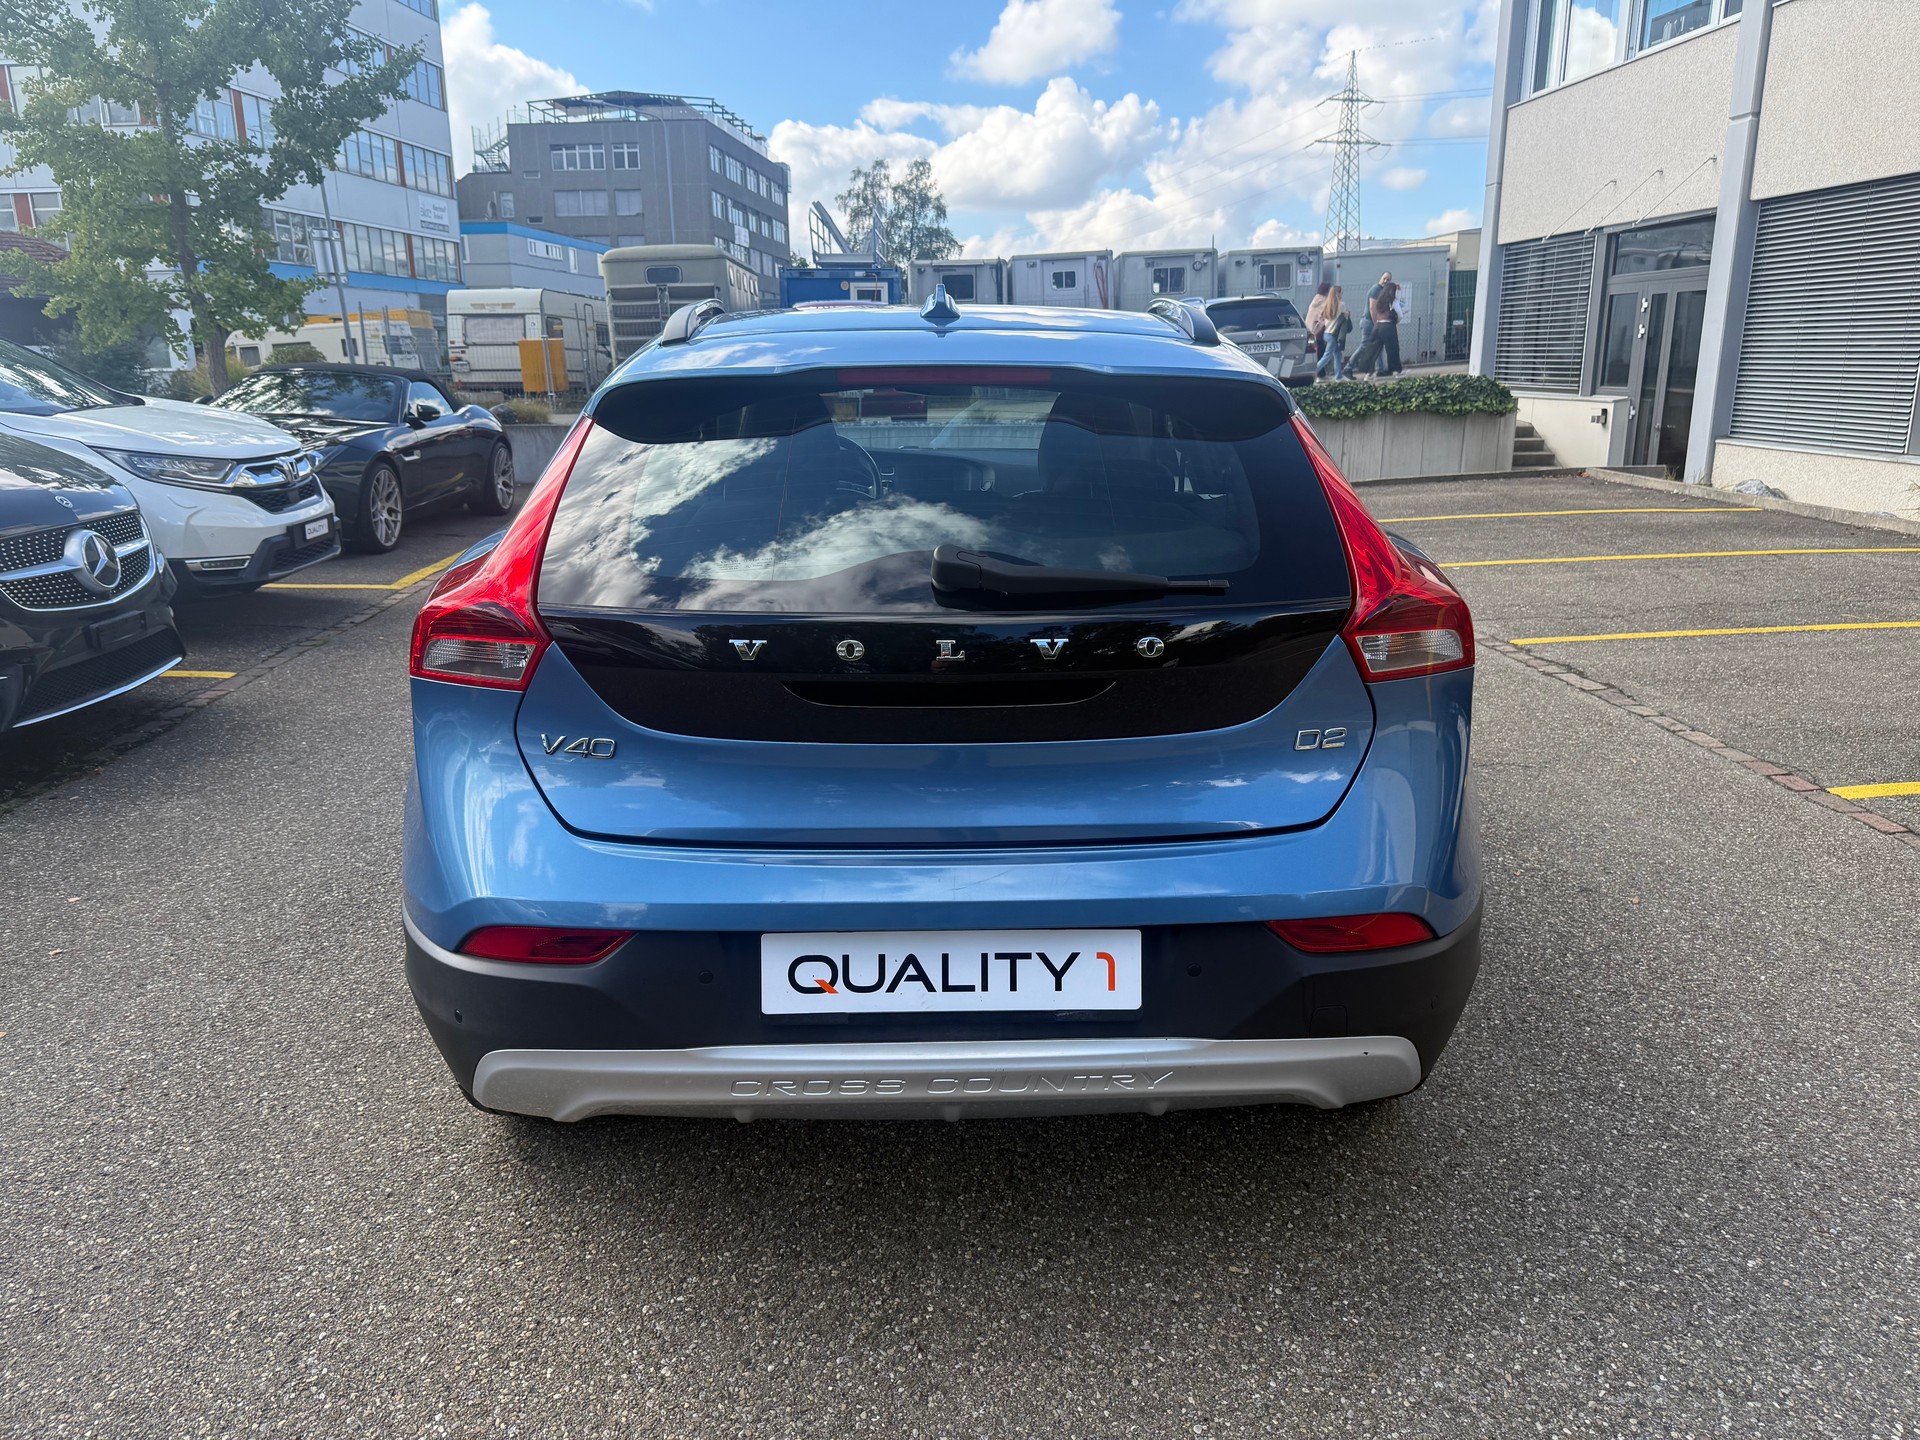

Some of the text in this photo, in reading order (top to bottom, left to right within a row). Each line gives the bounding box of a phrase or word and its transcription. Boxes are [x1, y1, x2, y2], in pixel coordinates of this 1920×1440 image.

[728, 637, 1165, 661] VOLVO
[541, 734, 615, 758] V40
[1295, 727, 1347, 750] D2
[787, 952, 1116, 994] QUALITY 1
[730, 1071, 1174, 1096] CROSS COUNTRY
